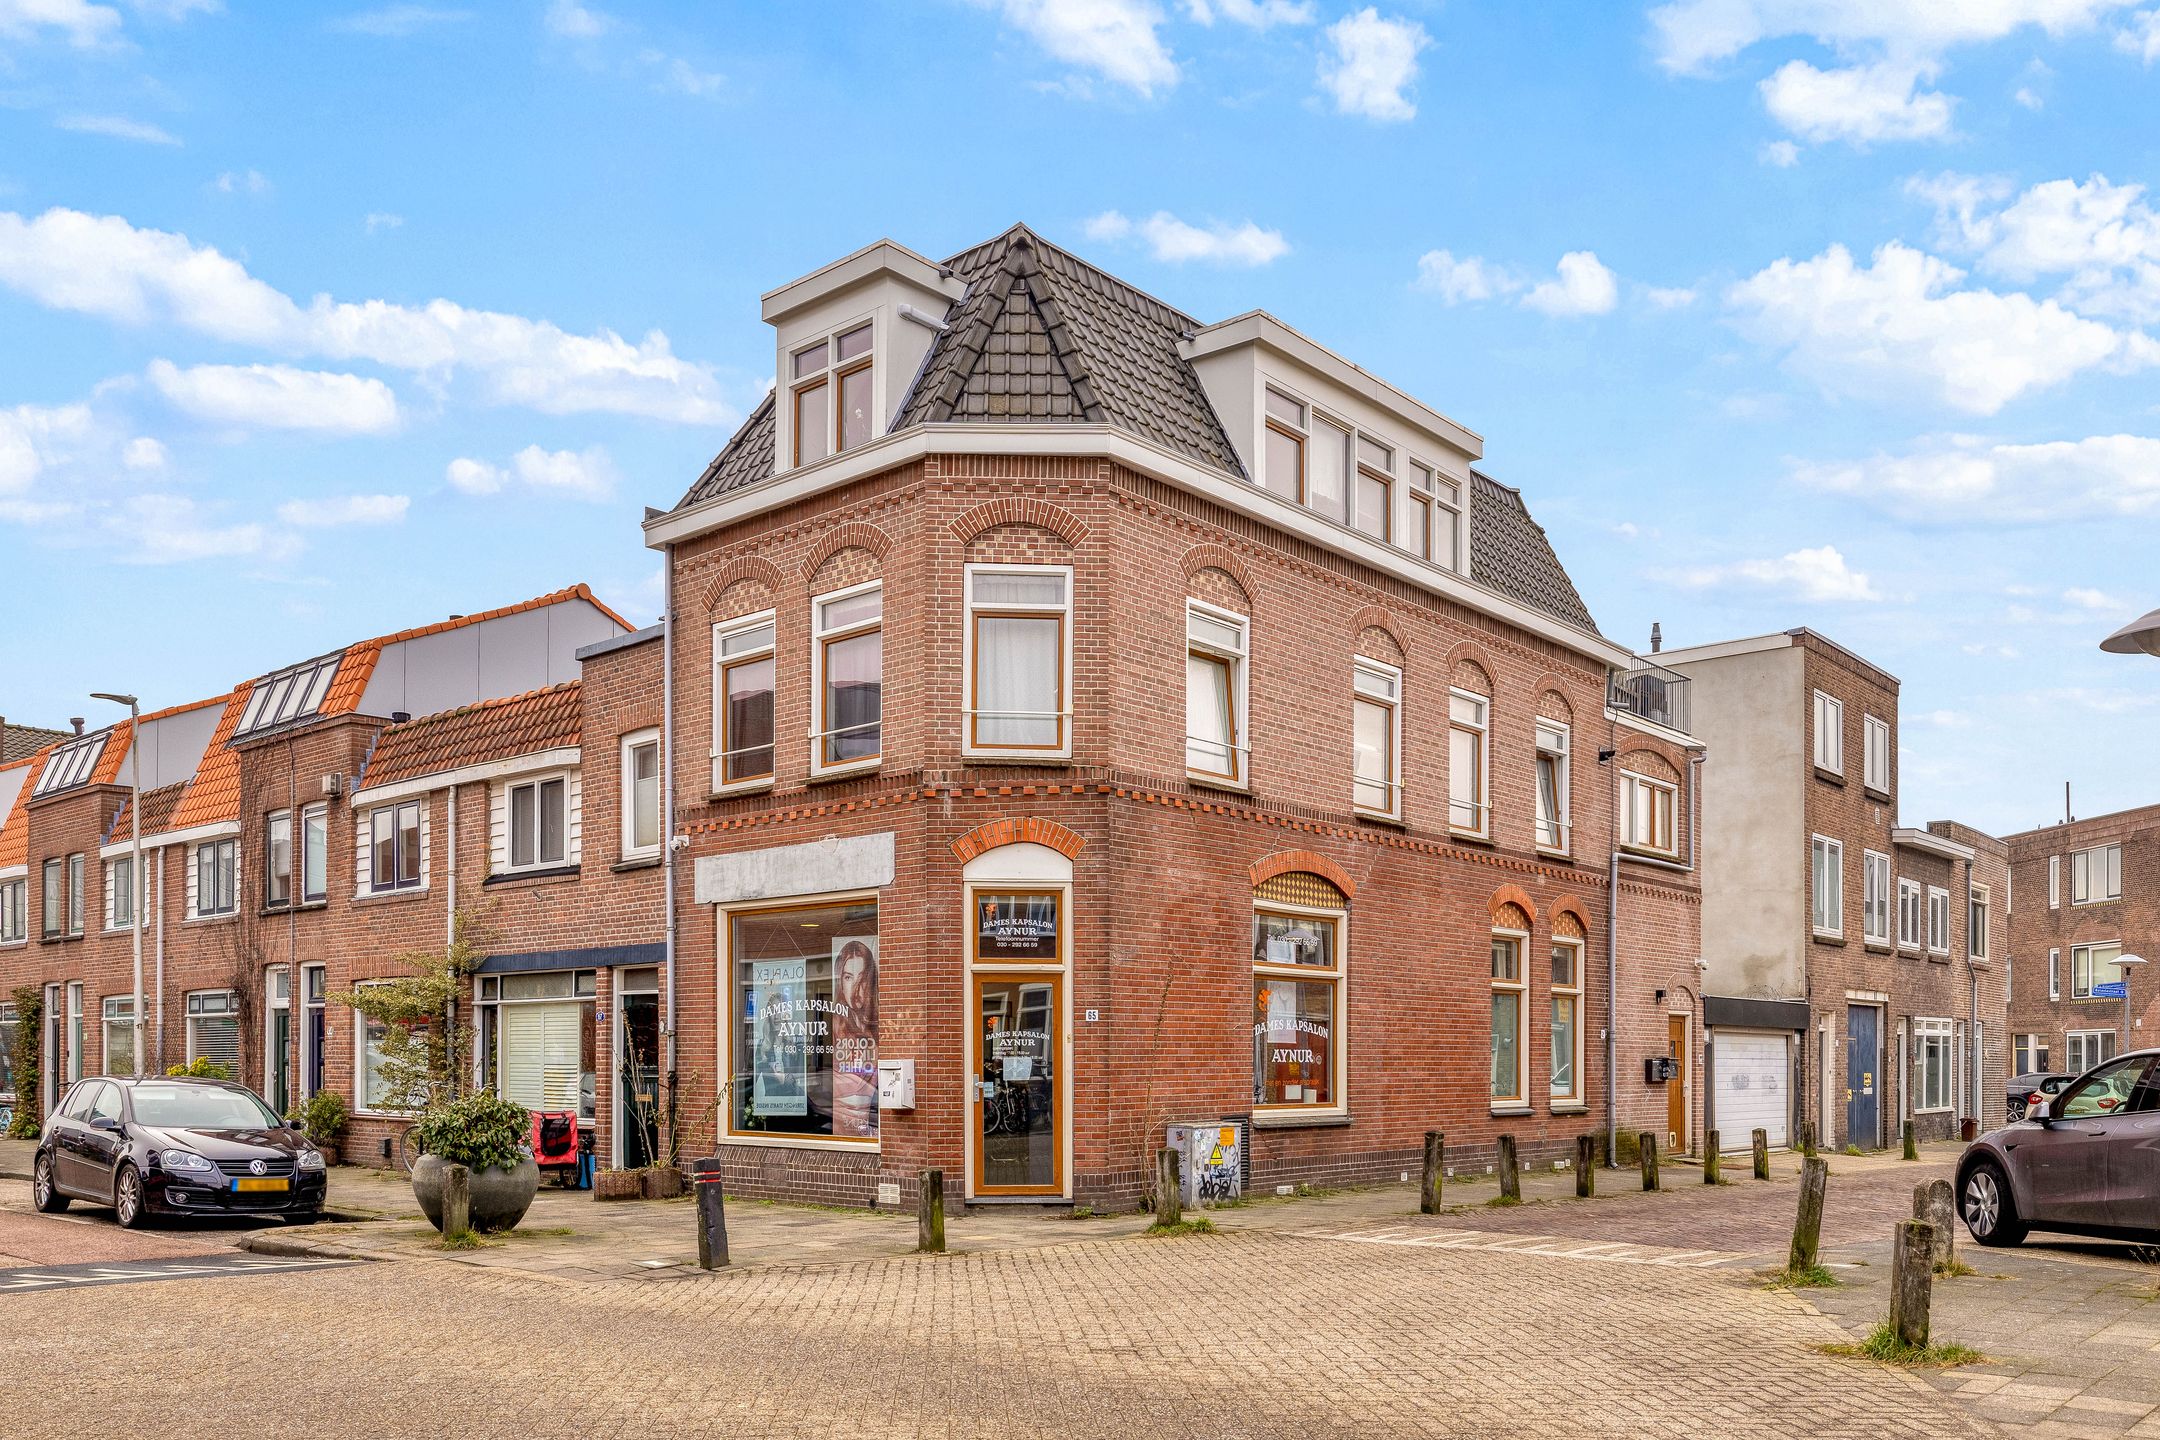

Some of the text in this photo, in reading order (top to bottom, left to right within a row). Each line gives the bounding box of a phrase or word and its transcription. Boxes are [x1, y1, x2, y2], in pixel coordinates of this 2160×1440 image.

[983, 919, 1053, 929] DAMES KAPSALON
[998, 928, 1038, 936] AYNUR
[760, 1001, 793, 1020] DAMES
[795, 1000, 849, 1017] KAPSALON
[1088, 1011, 1096, 1020] 65
[778, 1021, 828, 1037] AYNUR
[1254, 1019, 1328, 1039] DAMES KAPSALON
[985, 1031, 1050, 1040] DAMES KAPSALON
[785, 1045, 796, 1053] 030
[802, 1045, 815, 1054] 292
[816, 1045, 824, 1054] 66
[825, 1045, 834, 1054] 59
[1271, 1049, 1313, 1063] AYNUR
